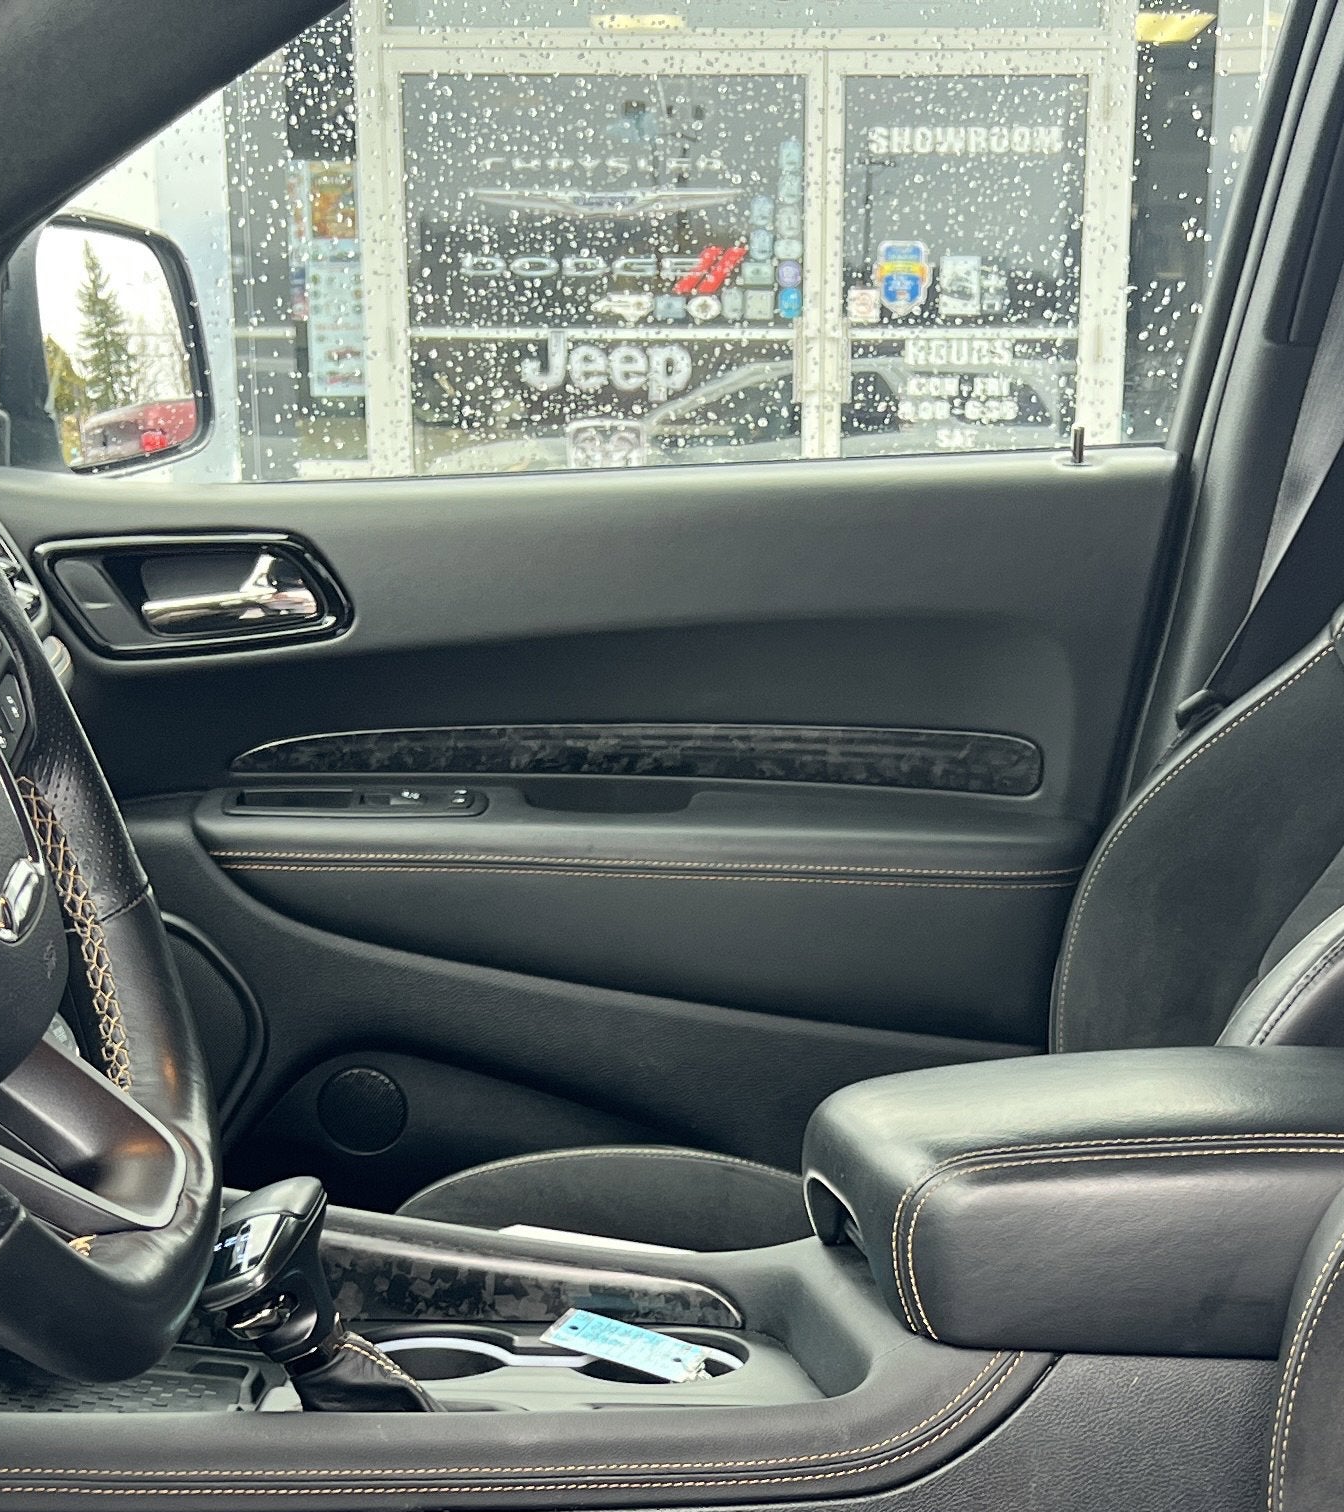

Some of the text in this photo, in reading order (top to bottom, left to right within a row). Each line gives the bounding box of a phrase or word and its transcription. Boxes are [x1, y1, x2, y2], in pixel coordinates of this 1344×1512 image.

[867, 126, 1063, 153] SHOWROOM
[479, 156, 724, 177] CHRYSLER
[460, 256, 706, 278] DODGE
[521, 331, 693, 401] Jeep
